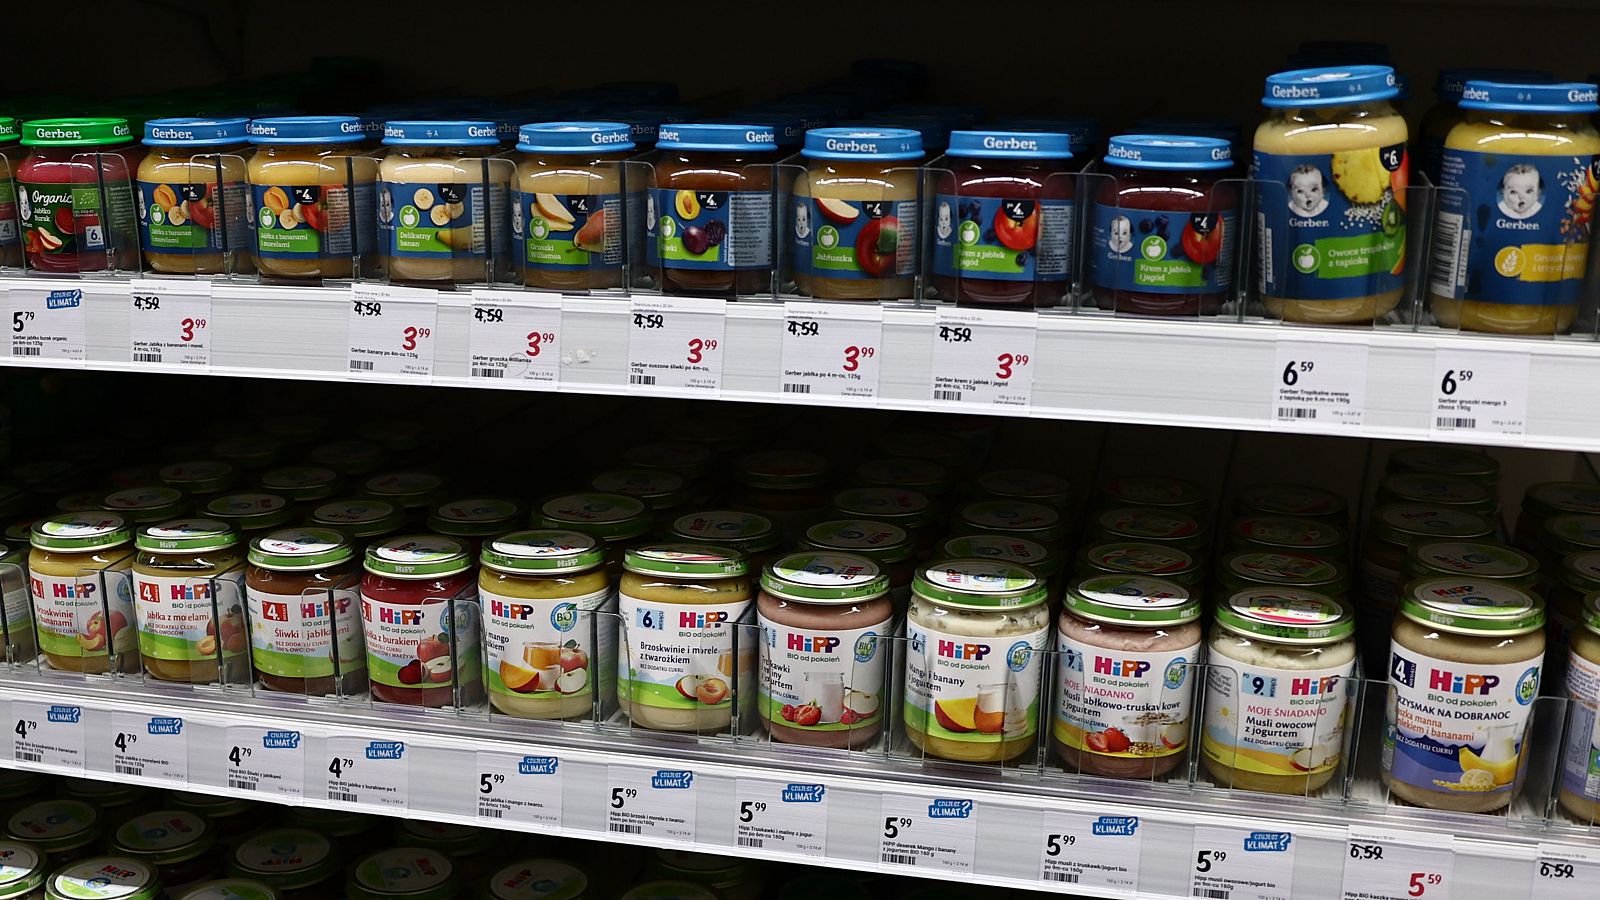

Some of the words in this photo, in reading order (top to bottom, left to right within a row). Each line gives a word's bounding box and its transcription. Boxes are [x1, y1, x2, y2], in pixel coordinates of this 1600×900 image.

[984, 136, 1038, 150] Gerber
[32, 190, 73, 206] Organic
[1289, 217, 1329, 228] Gerber
[1496, 218, 1540, 230] Gerber
[400, 231, 431, 241] Delikatny
[407, 351, 418, 359] 125g
[1279, 388, 1299, 396] Gerber
[1300, 389, 1330, 397] Tropikalne
[1438, 397, 1457, 405] Gerber
[53, 583, 96, 598] HiPP
[171, 583, 222, 601] HiPP
[380, 607, 424, 626] HiPP
[491, 600, 534, 621] HiPP
[509, 621, 535, 630] pokoleń
[679, 611, 729, 628] HiPP
[274, 628, 299, 639] Śliwki
[488, 631, 510, 645] mango
[692, 630, 702, 638] od
[640, 641, 686, 654] Brzoskwinie
[787, 633, 841, 653] HiPP
[938, 639, 991, 660] HiPP
[645, 651, 690, 665] twarożkiem
[787, 652, 799, 660] BIO
[800, 653, 810, 662] od
[810, 655, 840, 663] pokoleń
[950, 661, 960, 669] od
[961, 662, 990, 671] pokoleń
[1094, 656, 1151, 678] HiPP
[933, 671, 965, 687] banany
[1093, 676, 1106, 684] BIO
[1107, 678, 1118, 687] od
[1119, 680, 1150, 689] pokoleń
[1291, 675, 1340, 696] HiPP
[1429, 668, 1500, 695] HiPP
[1521, 679, 1536, 693] BIO
[1290, 698, 1304, 706] BIO
[1304, 698, 1315, 706] od
[1427, 693, 1444, 703] BIO
[1446, 695, 1458, 704] od
[1459, 698, 1498, 709] pokoleń
[1437, 708, 1453, 720] NA
[1454, 709, 1511, 721] DOBRANOC
[1246, 715, 1273, 728] Musli
[1250, 725, 1298, 741] jogurtem
[1254, 738, 1284, 747] DODATKU
[896, 842, 916, 850] deserek
[938, 846, 957, 854] banany
[1194, 875, 1207, 883] Hipp
[1221, 883, 1234, 891] 160g
